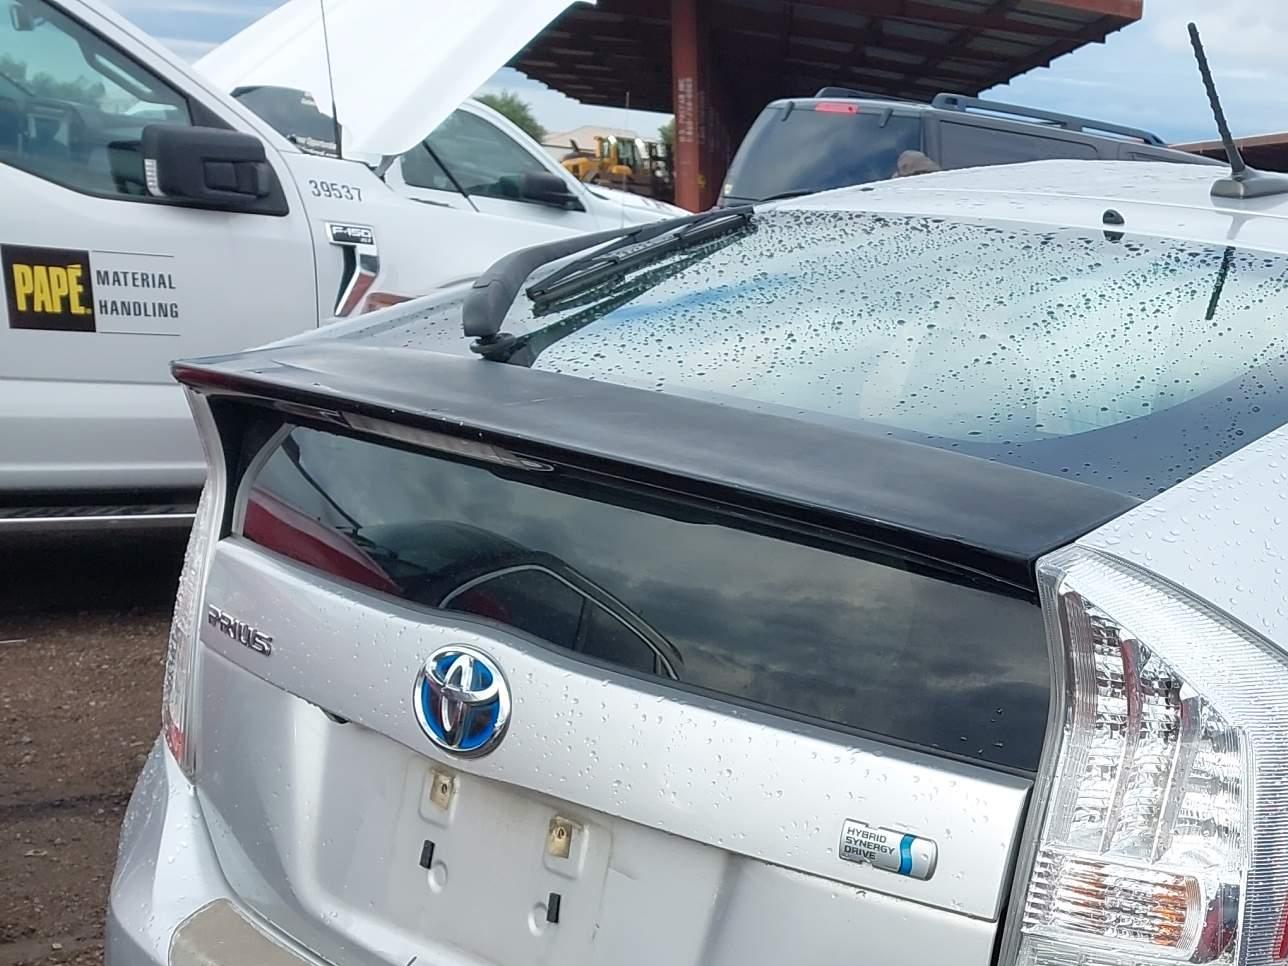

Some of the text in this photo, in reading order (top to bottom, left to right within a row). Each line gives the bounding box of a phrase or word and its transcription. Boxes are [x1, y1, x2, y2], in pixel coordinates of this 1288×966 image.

[309, 180, 362, 202] 39537
[96, 270, 176, 290] MATERIAL
[99, 300, 178, 318] HANDLING
[208, 604, 273, 656] PRIUS
[846, 826, 887, 843] HYBRID
[844, 845, 876, 860] DRIVE
[845, 836, 896, 855] SYNERGY
